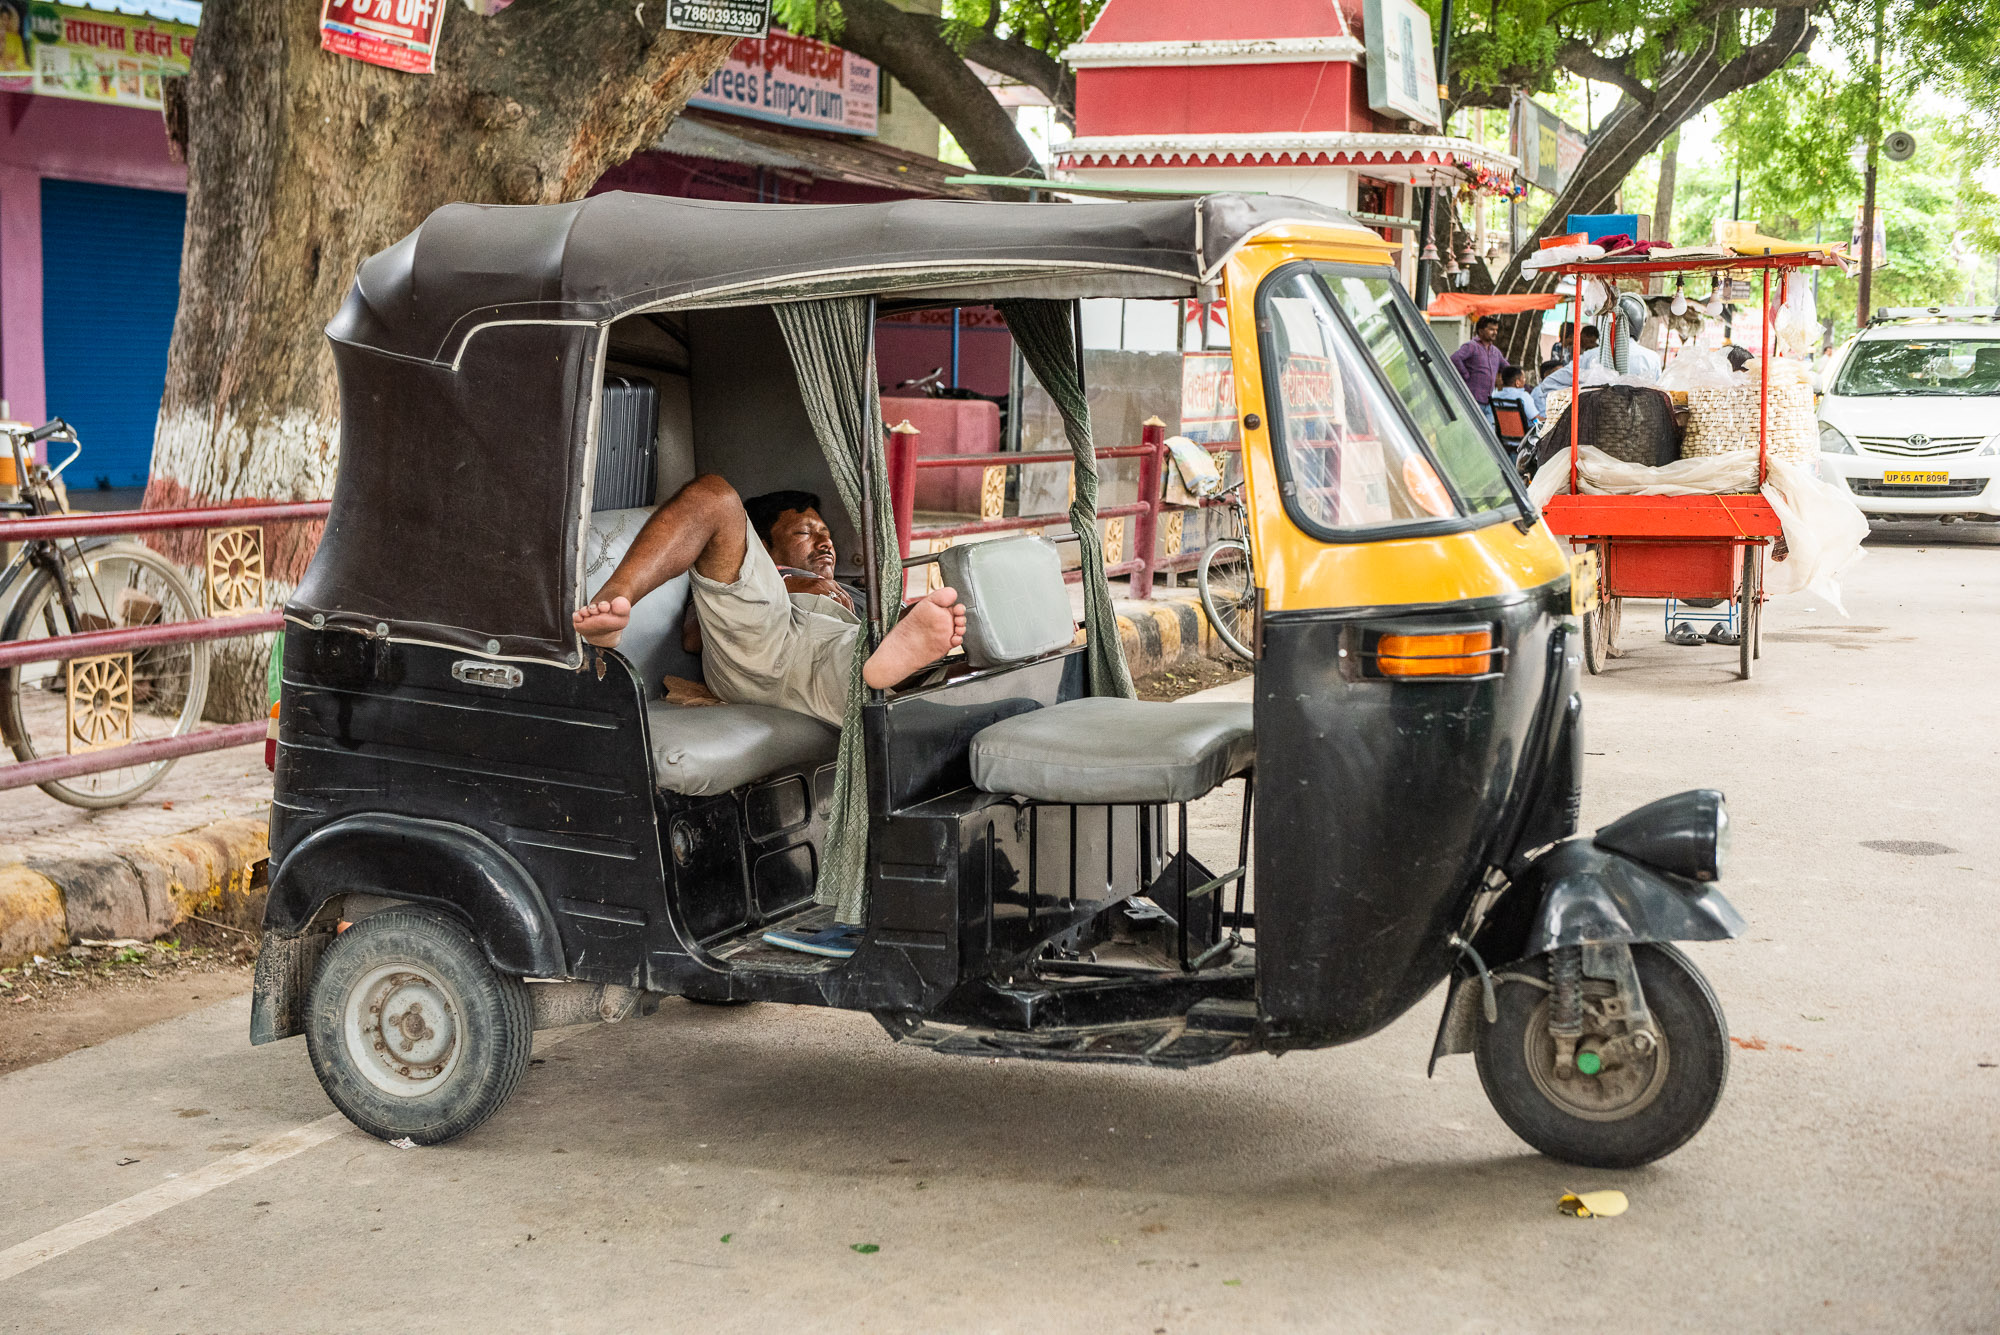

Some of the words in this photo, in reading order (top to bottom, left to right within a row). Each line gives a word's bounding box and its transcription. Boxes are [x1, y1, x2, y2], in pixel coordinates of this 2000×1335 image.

[396, 0, 435, 29] OFF
[683, 5, 761, 27] 7860393390
[702, 69, 757, 103] arees
[763, 71, 843, 120] Emporium
[920, 309, 991, 327] Socety.
[1886, 474, 1899, 482] UP
[1900, 474, 1911, 482] 65
[1913, 474, 1924, 482] AT
[1926, 474, 1947, 483] 8096
